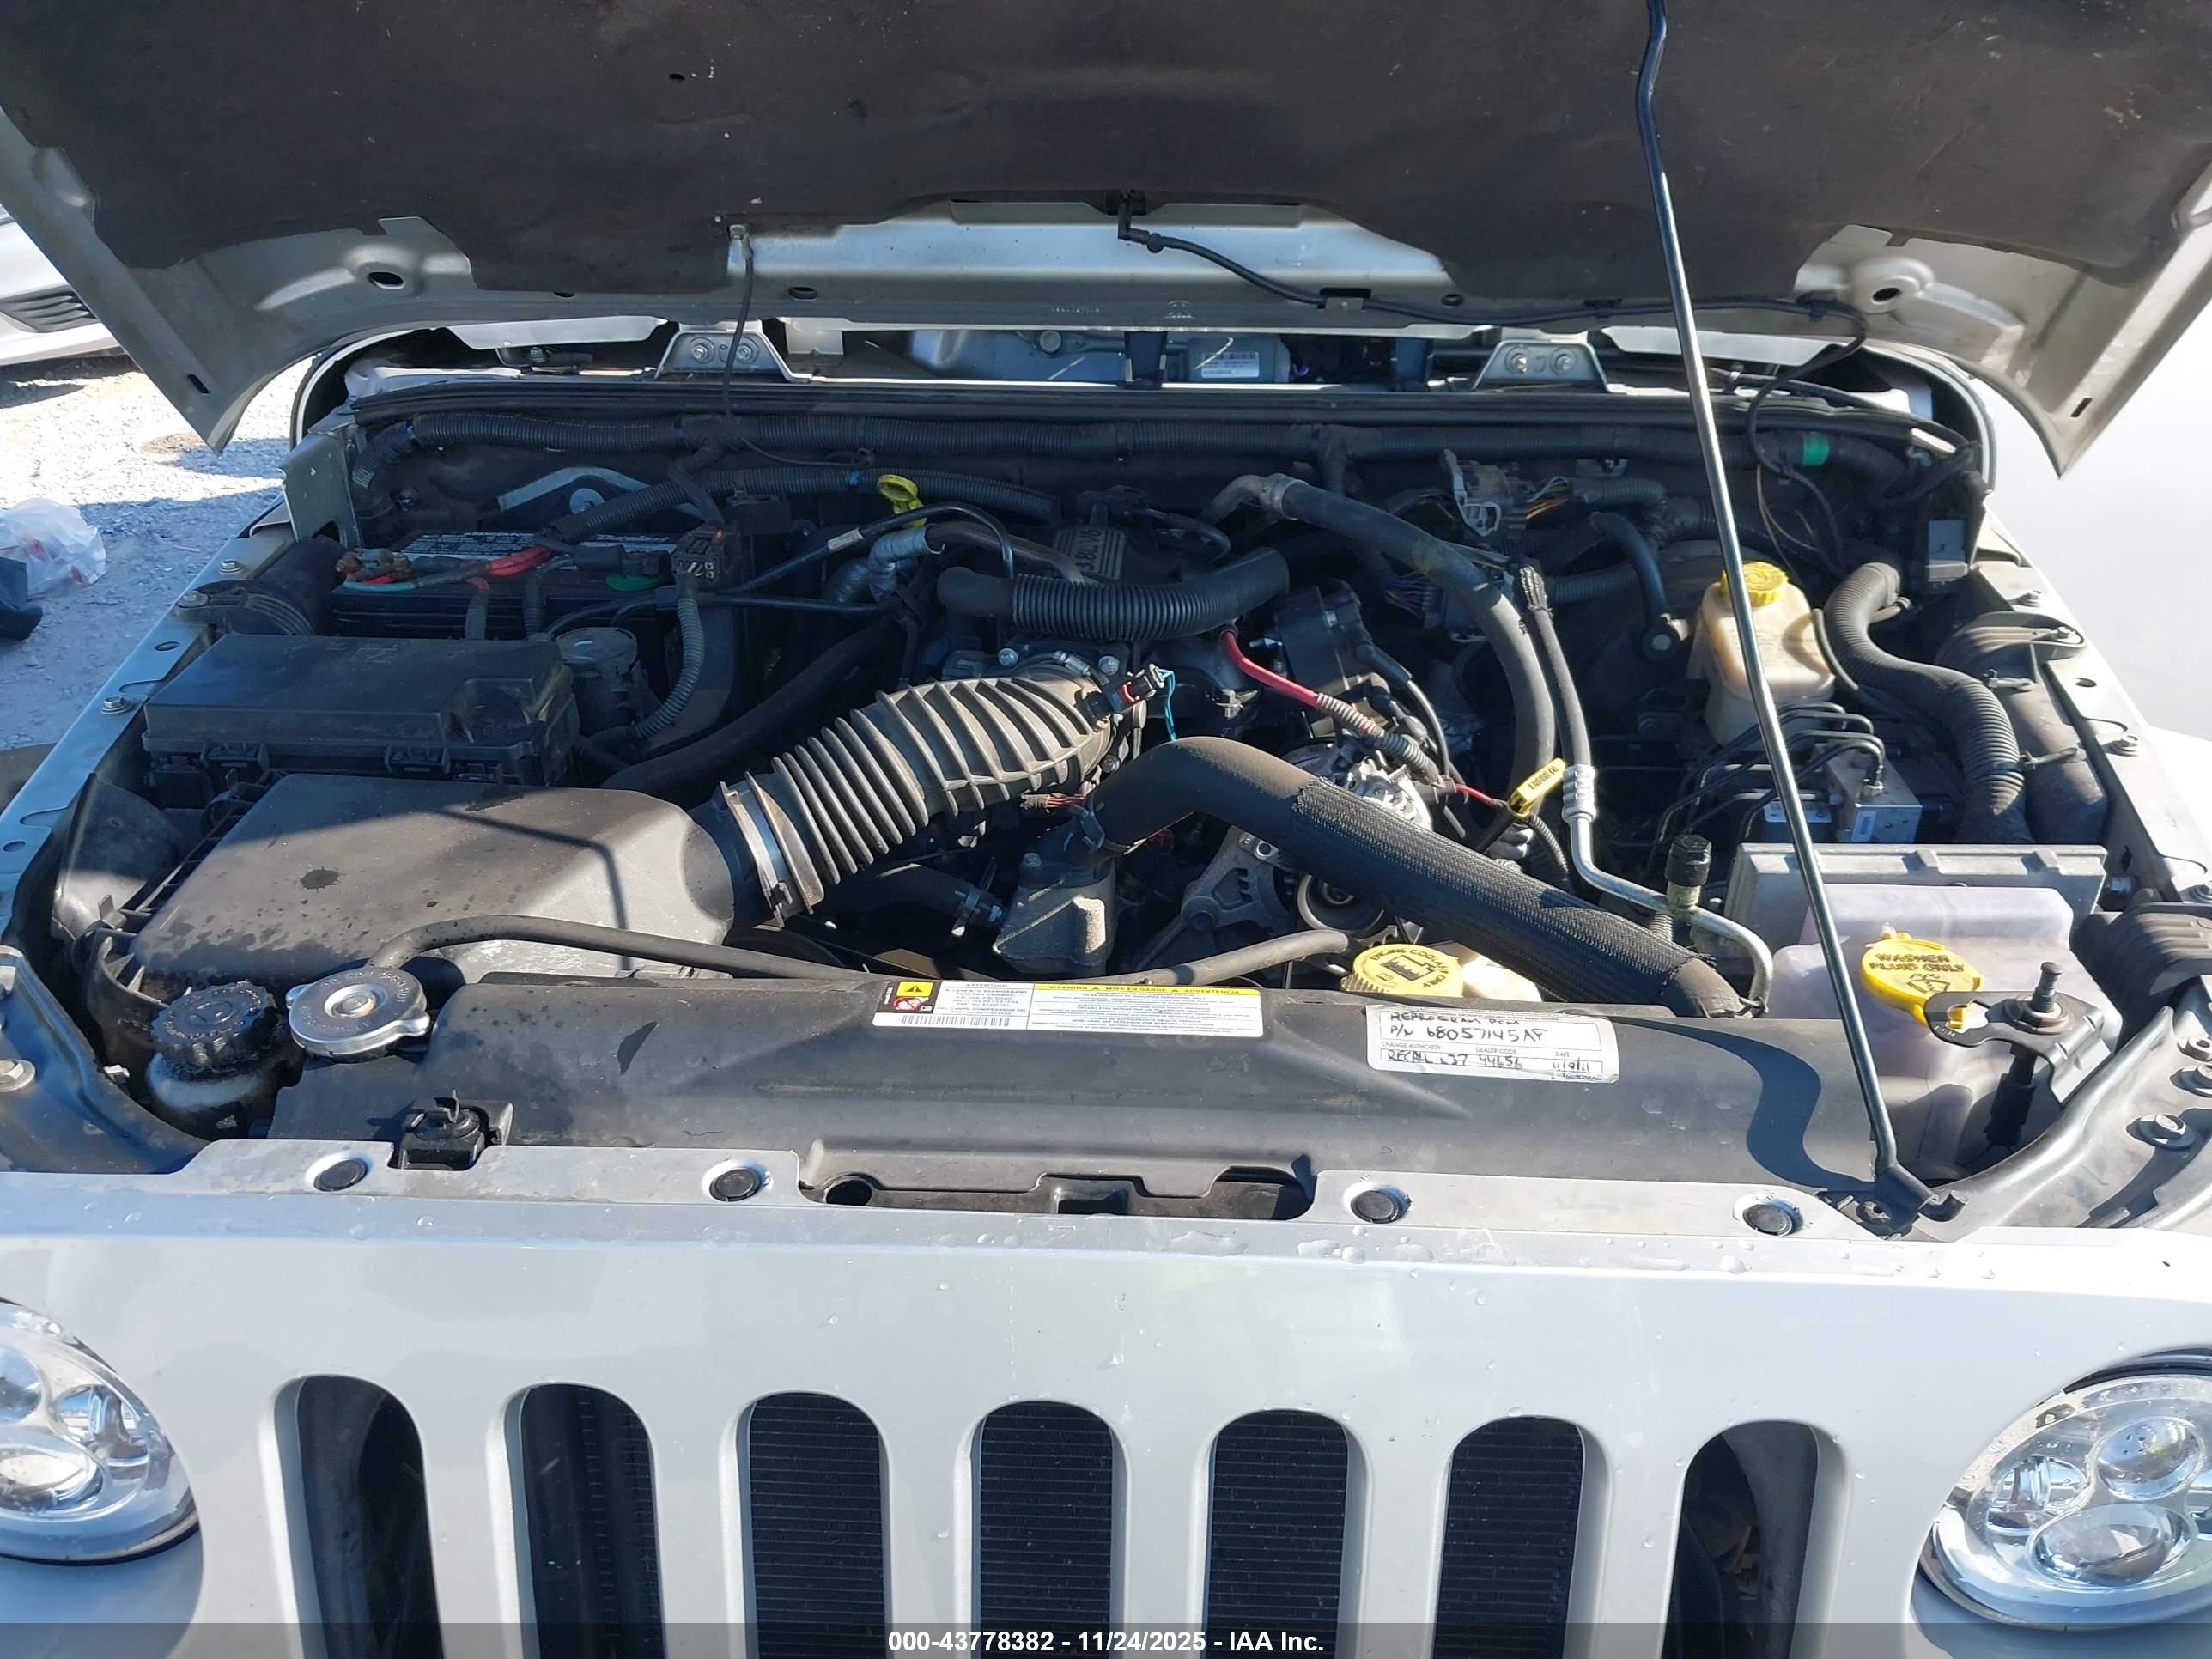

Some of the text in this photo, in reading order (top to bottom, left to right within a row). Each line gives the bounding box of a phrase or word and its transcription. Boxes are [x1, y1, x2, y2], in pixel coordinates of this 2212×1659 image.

[1875, 953, 1950, 963] WASHER
[1869, 962, 1964, 972] FLUID ONLY
